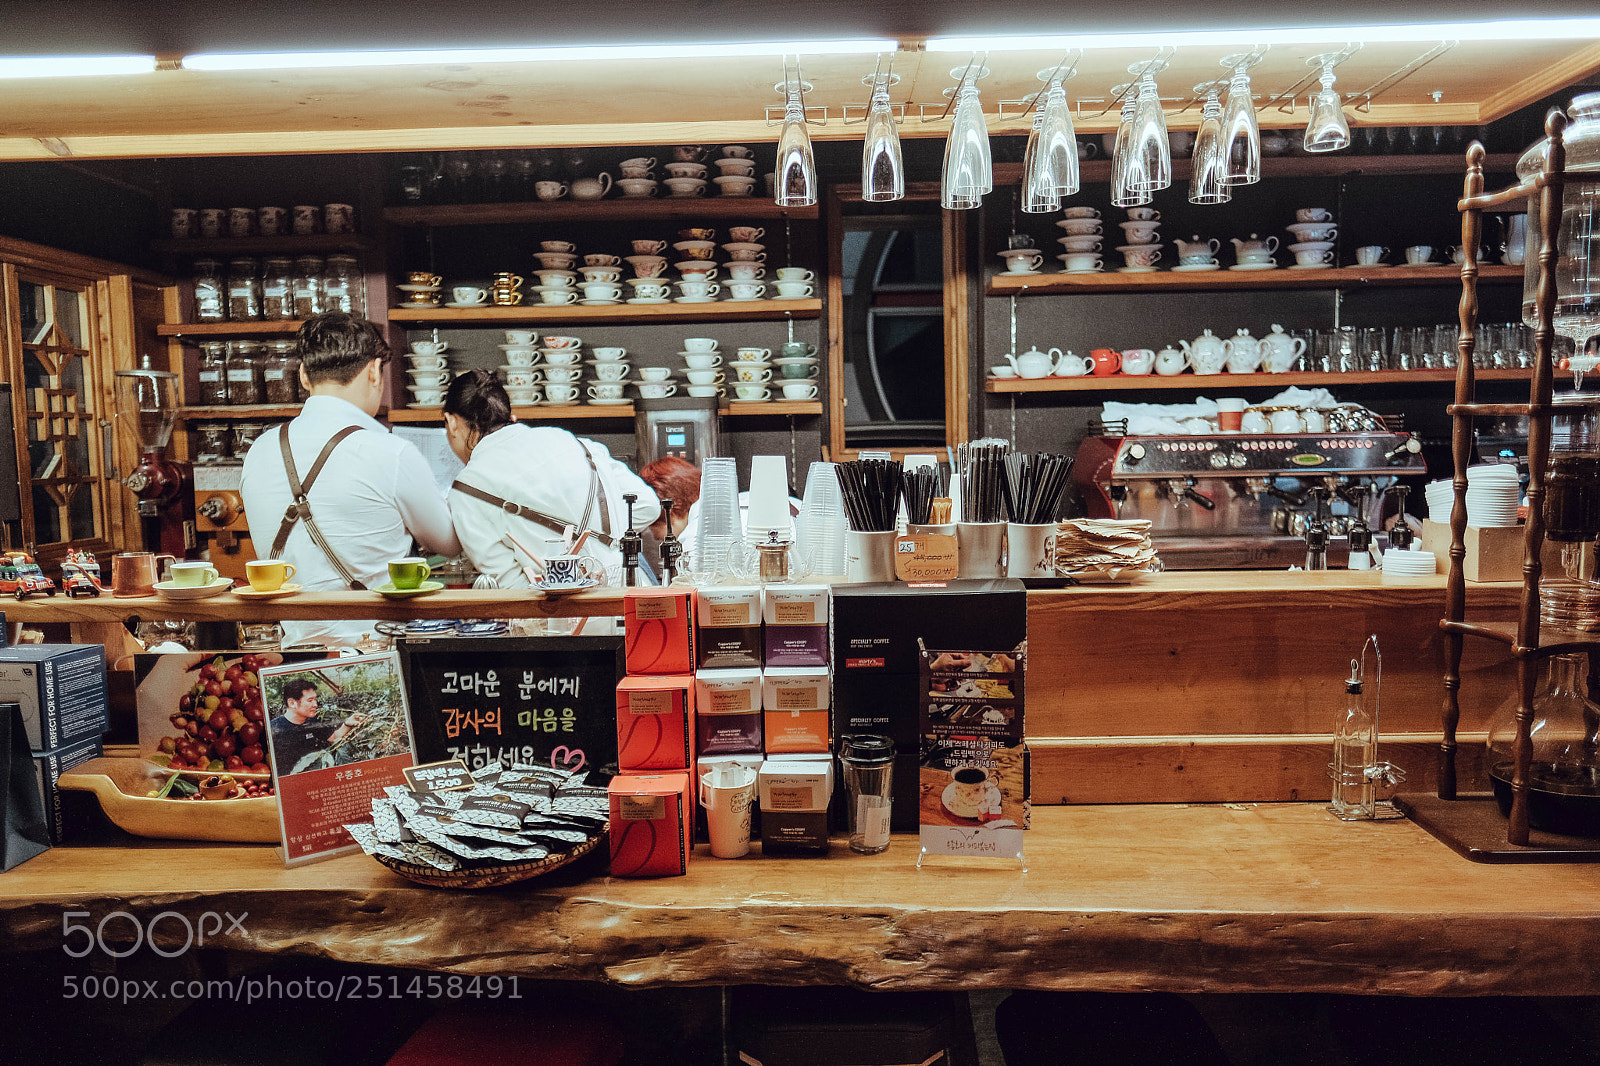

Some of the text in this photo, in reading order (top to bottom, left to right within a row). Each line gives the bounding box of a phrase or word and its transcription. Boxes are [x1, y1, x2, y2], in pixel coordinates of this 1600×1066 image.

[46, 675, 54, 700] HOME
[441, 670, 580, 700] 고마운 분에게
[47, 700, 56, 716] FOR
[442, 707, 576, 738] 감사의 마음을
[48, 716, 58, 749] PERFECT
[49, 754, 57, 769] USE
[954, 749, 989, 758] 드립백으로
[335, 769, 363, 782] 우종호
[427, 778, 462, 790] 1.500
